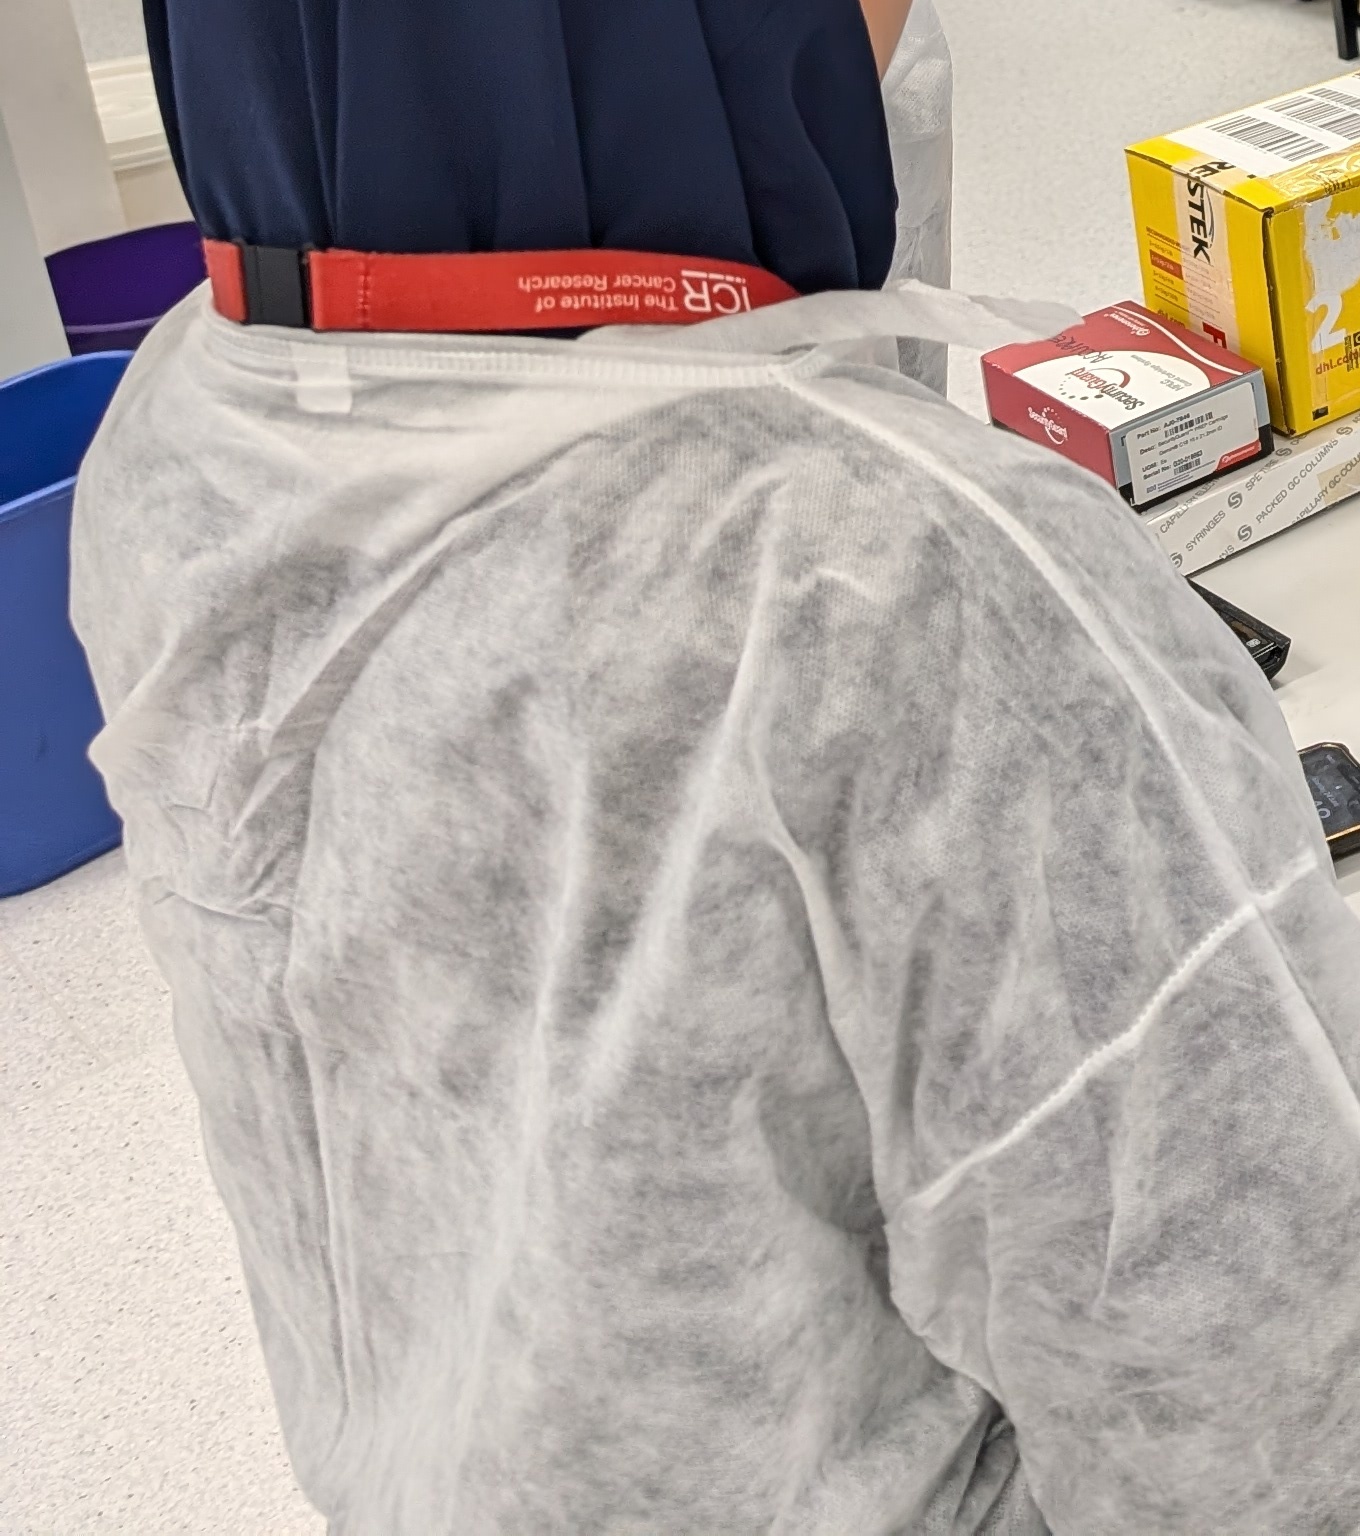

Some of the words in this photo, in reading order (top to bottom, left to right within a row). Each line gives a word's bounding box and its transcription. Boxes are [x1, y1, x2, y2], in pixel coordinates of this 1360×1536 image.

[517, 275, 608, 293] Research
[612, 276, 677, 293] Cancer
[534, 296, 556, 313] of
[560, 294, 640, 311] Institute
[645, 295, 679, 312] The
[681, 277, 752, 314] ICR
[1305, 291, 1347, 354] 2
[1315, 349, 1360, 376] dhl.com
[1065, 367, 1146, 410] SecurityGuard
[1136, 430, 1150, 440] Part
[1245, 471, 1263, 492] SPE
[1256, 489, 1288, 524] PACKED
[1288, 475, 1302, 492] GC
[1301, 438, 1339, 479] COLUMNS
[1329, 473, 1343, 490] GC
[1185, 509, 1226, 552] SYRINGES
